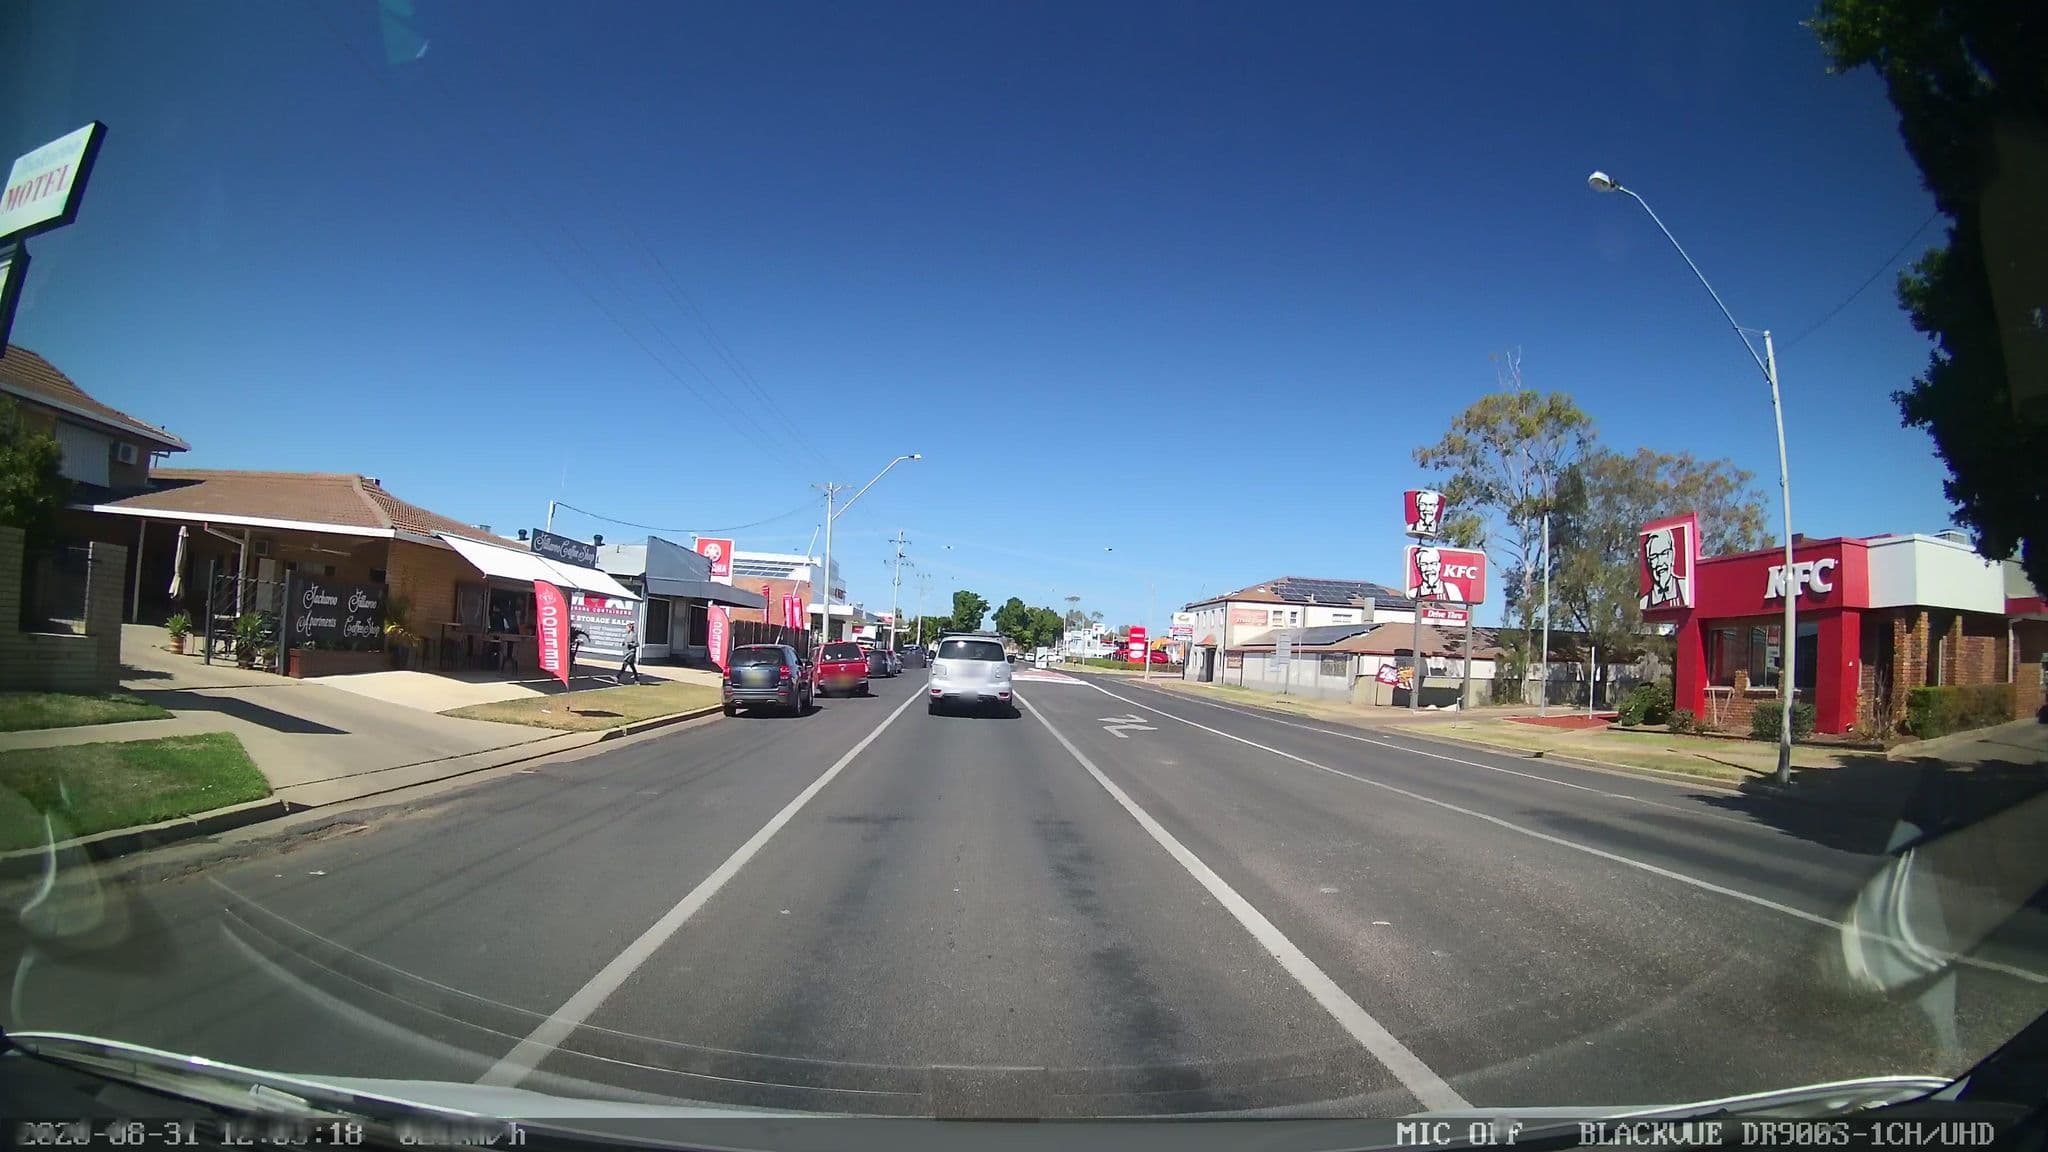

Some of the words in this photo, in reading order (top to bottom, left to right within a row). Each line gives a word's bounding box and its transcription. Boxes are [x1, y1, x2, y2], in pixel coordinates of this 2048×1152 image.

[1443, 564, 1478, 580] KFC
[1764, 559, 1835, 599] KFC
[296, 610, 337, 637] Apartments
